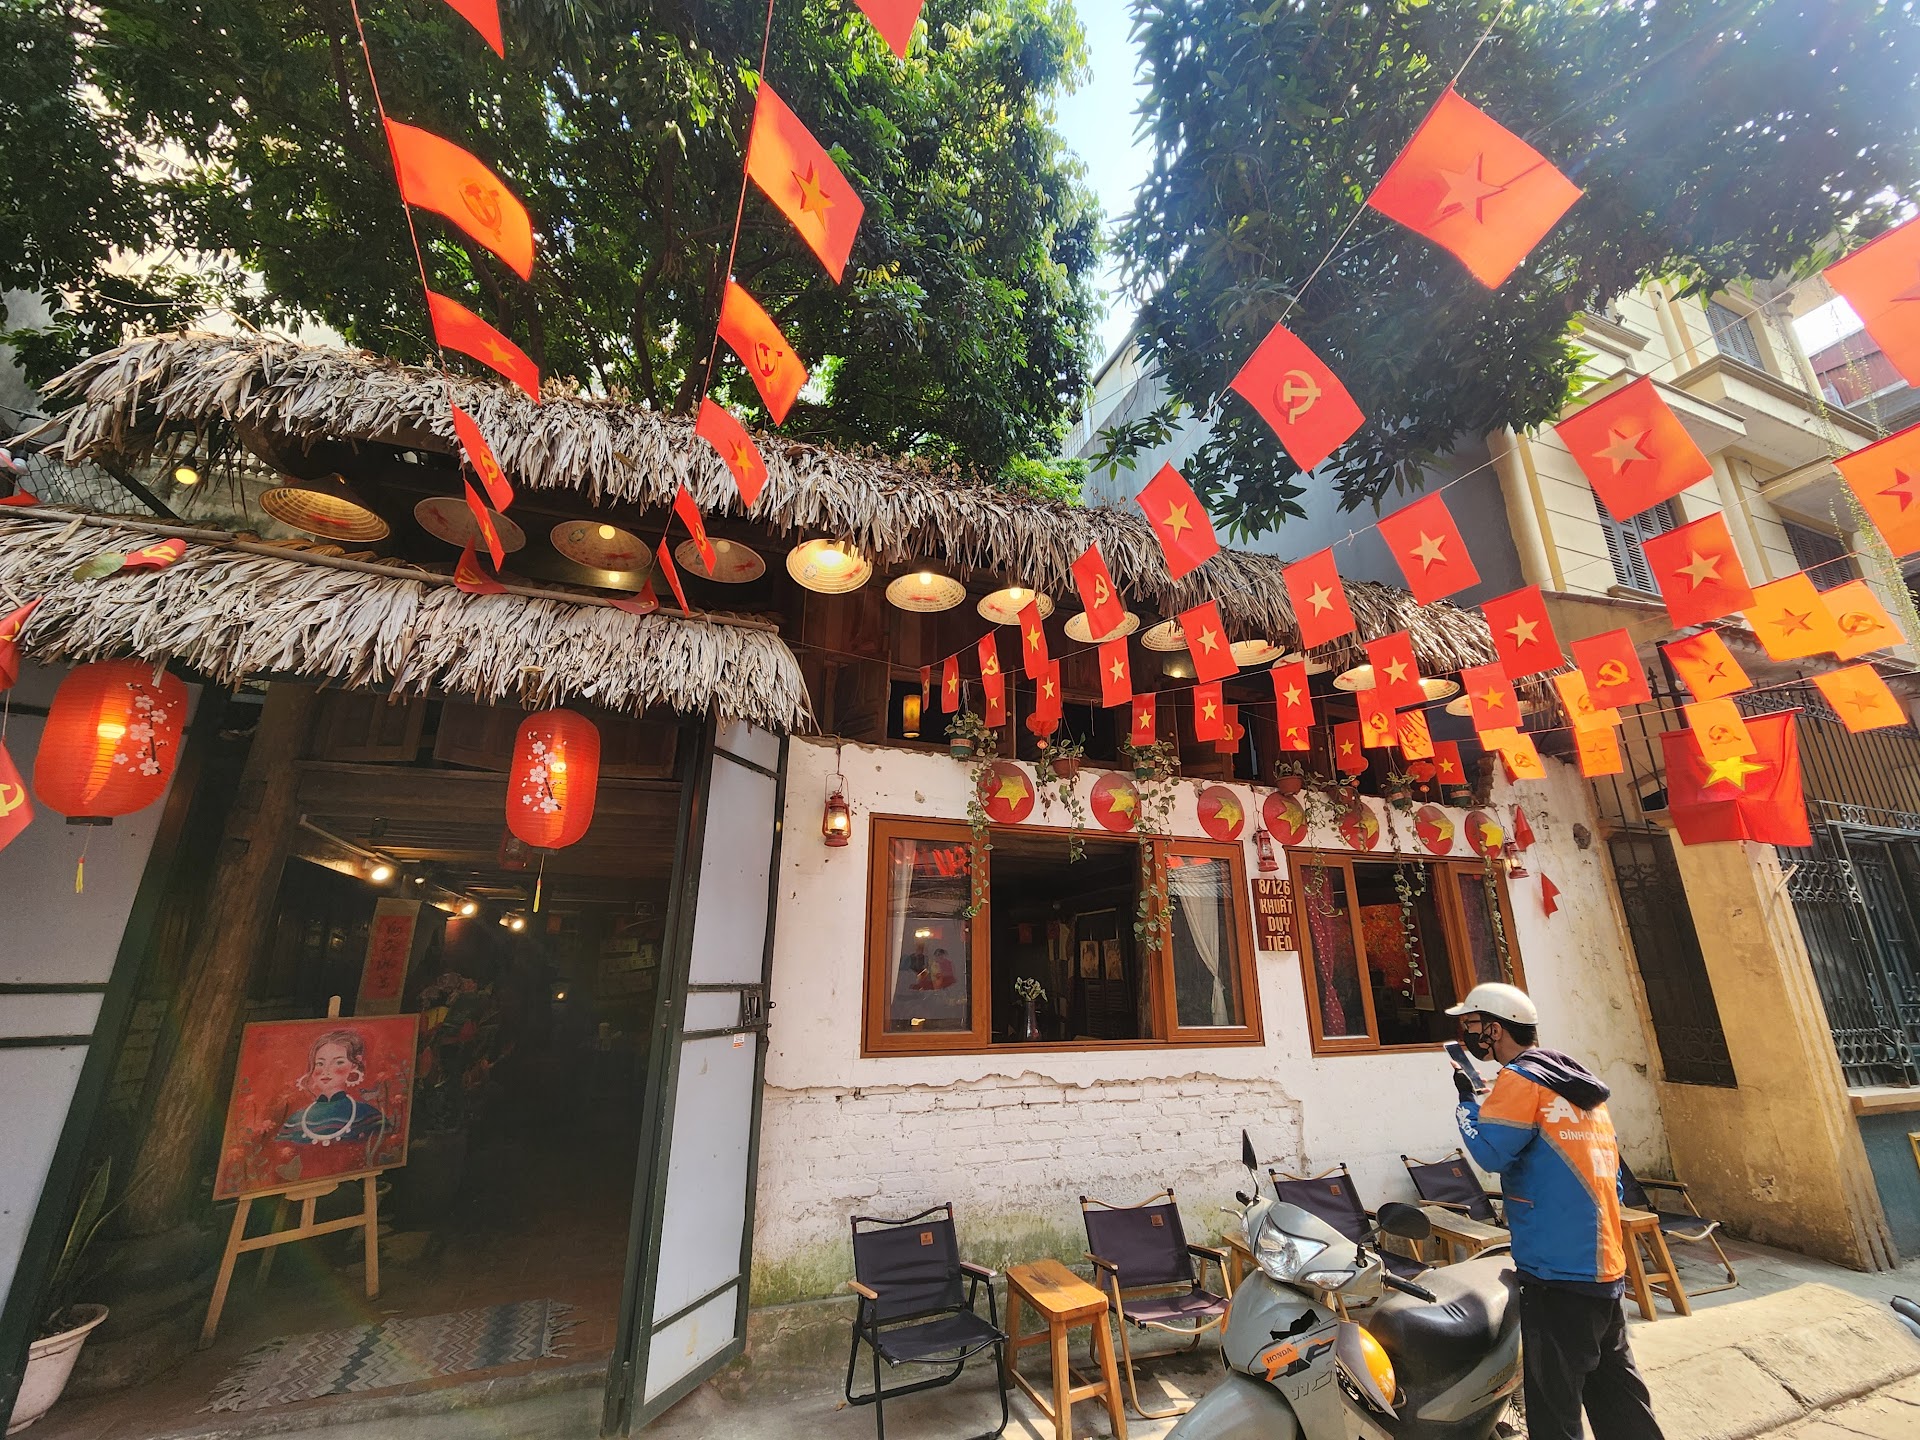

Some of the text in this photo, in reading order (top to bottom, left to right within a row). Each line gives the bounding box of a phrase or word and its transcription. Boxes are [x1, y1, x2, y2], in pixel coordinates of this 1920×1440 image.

[1258, 879, 1291, 895] 8/126
[1267, 916, 1291, 932] DUY
[1266, 1347, 1293, 1364] HONDA
